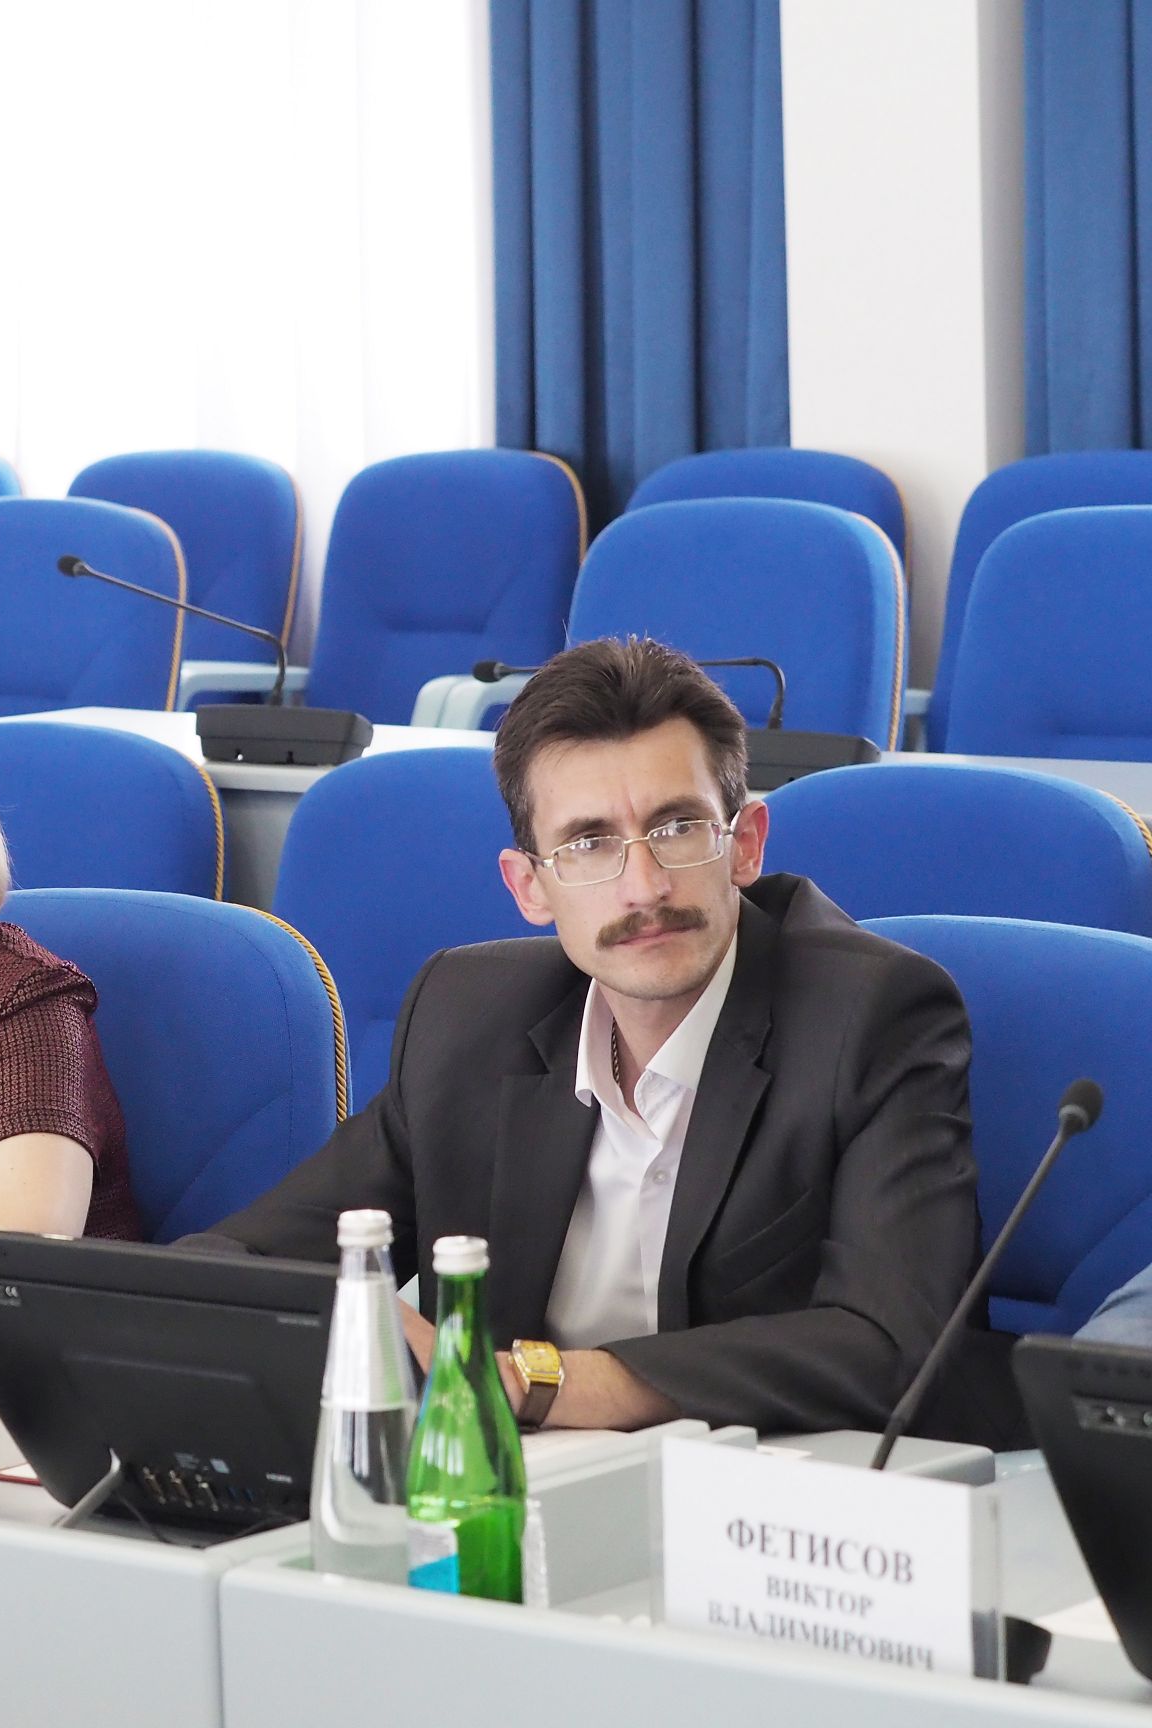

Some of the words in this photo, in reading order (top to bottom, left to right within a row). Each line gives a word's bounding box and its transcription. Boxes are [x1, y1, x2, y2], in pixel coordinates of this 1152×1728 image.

[726, 1517, 914, 1584] ФЕТИСОВ
[766, 1574, 873, 1618] ВИКТОР
[707, 1600, 935, 1672] ВЛАДИМИРОВИЧ
